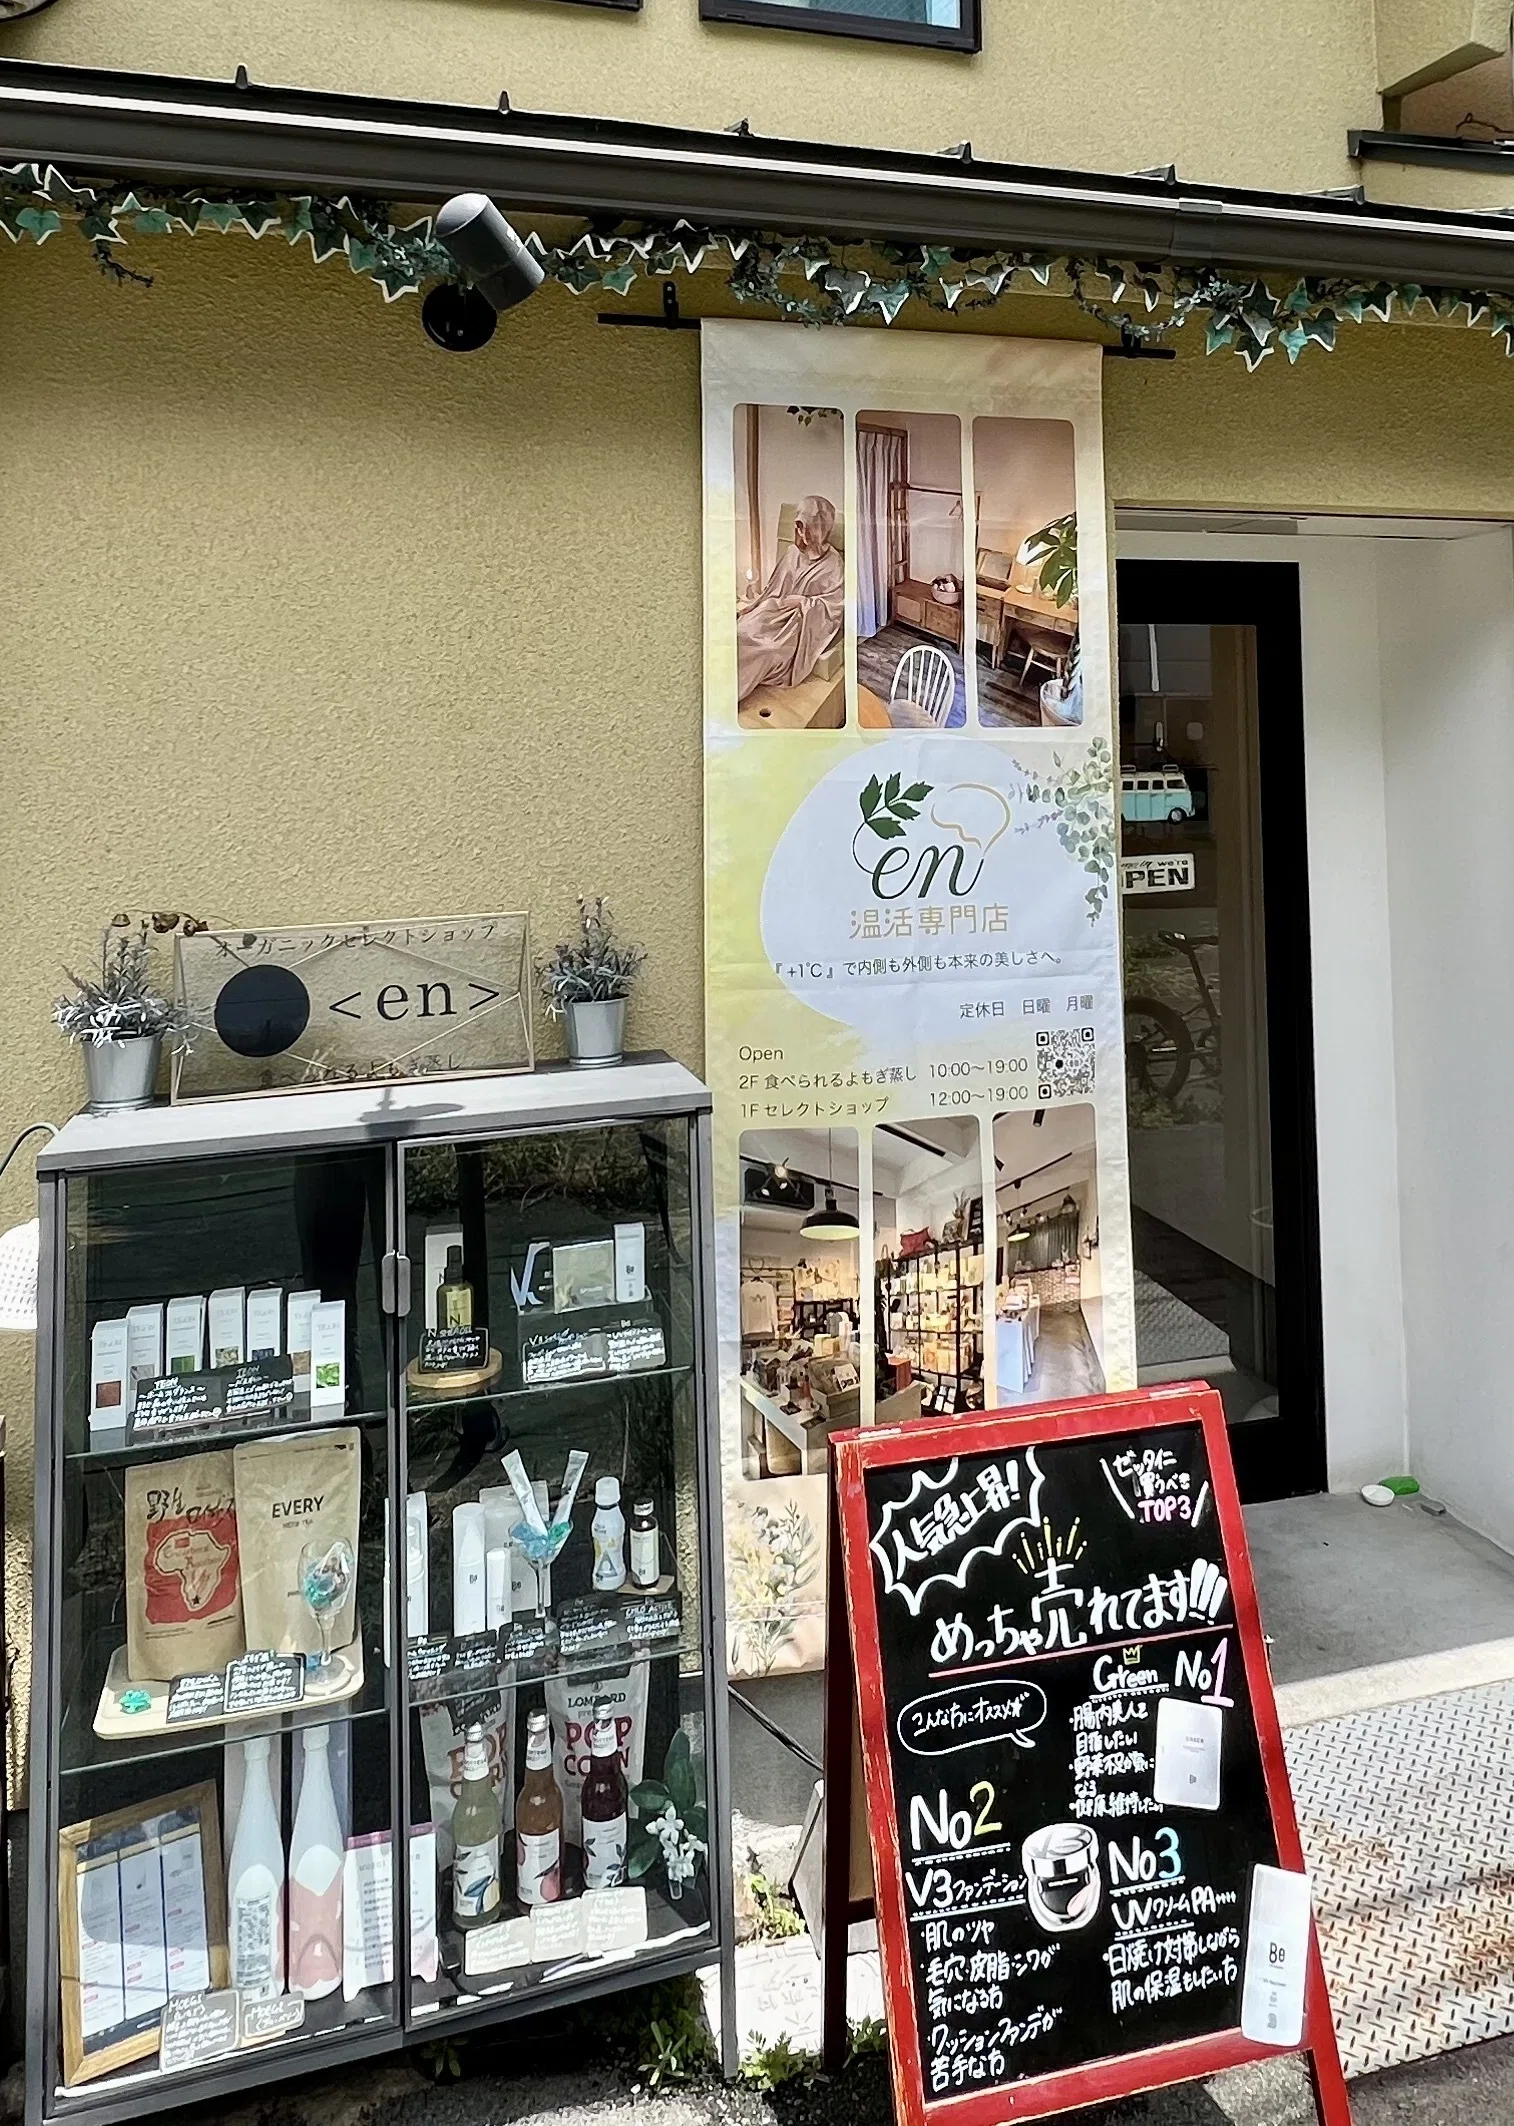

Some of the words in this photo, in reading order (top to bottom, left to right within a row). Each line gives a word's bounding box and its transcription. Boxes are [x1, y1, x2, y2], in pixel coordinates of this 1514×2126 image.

[870, 844, 985, 900] en
[1120, 866, 1189, 889] PEN
[848, 902, 1009, 941] 温活専門店
[958, 1001, 1005, 1020] 定休日
[1021, 997, 1051, 1016] 日曜
[1065, 994, 1094, 1013] 月曜
[738, 1045, 785, 1064] Open
[738, 1074, 760, 1091] 2F
[764, 1066, 918, 1091] 食べられるよもぎ蒸し
[741, 1102, 760, 1119] 1F
[764, 1095, 890, 1118] セレクトショップ
[271, 1495, 325, 1519] EVERY
[1137, 1494, 1192, 1523] TOP3
[1092, 1654, 1159, 1693] Green
[909, 1780, 1003, 1851] No2
[1107, 1826, 1182, 1886] No3
